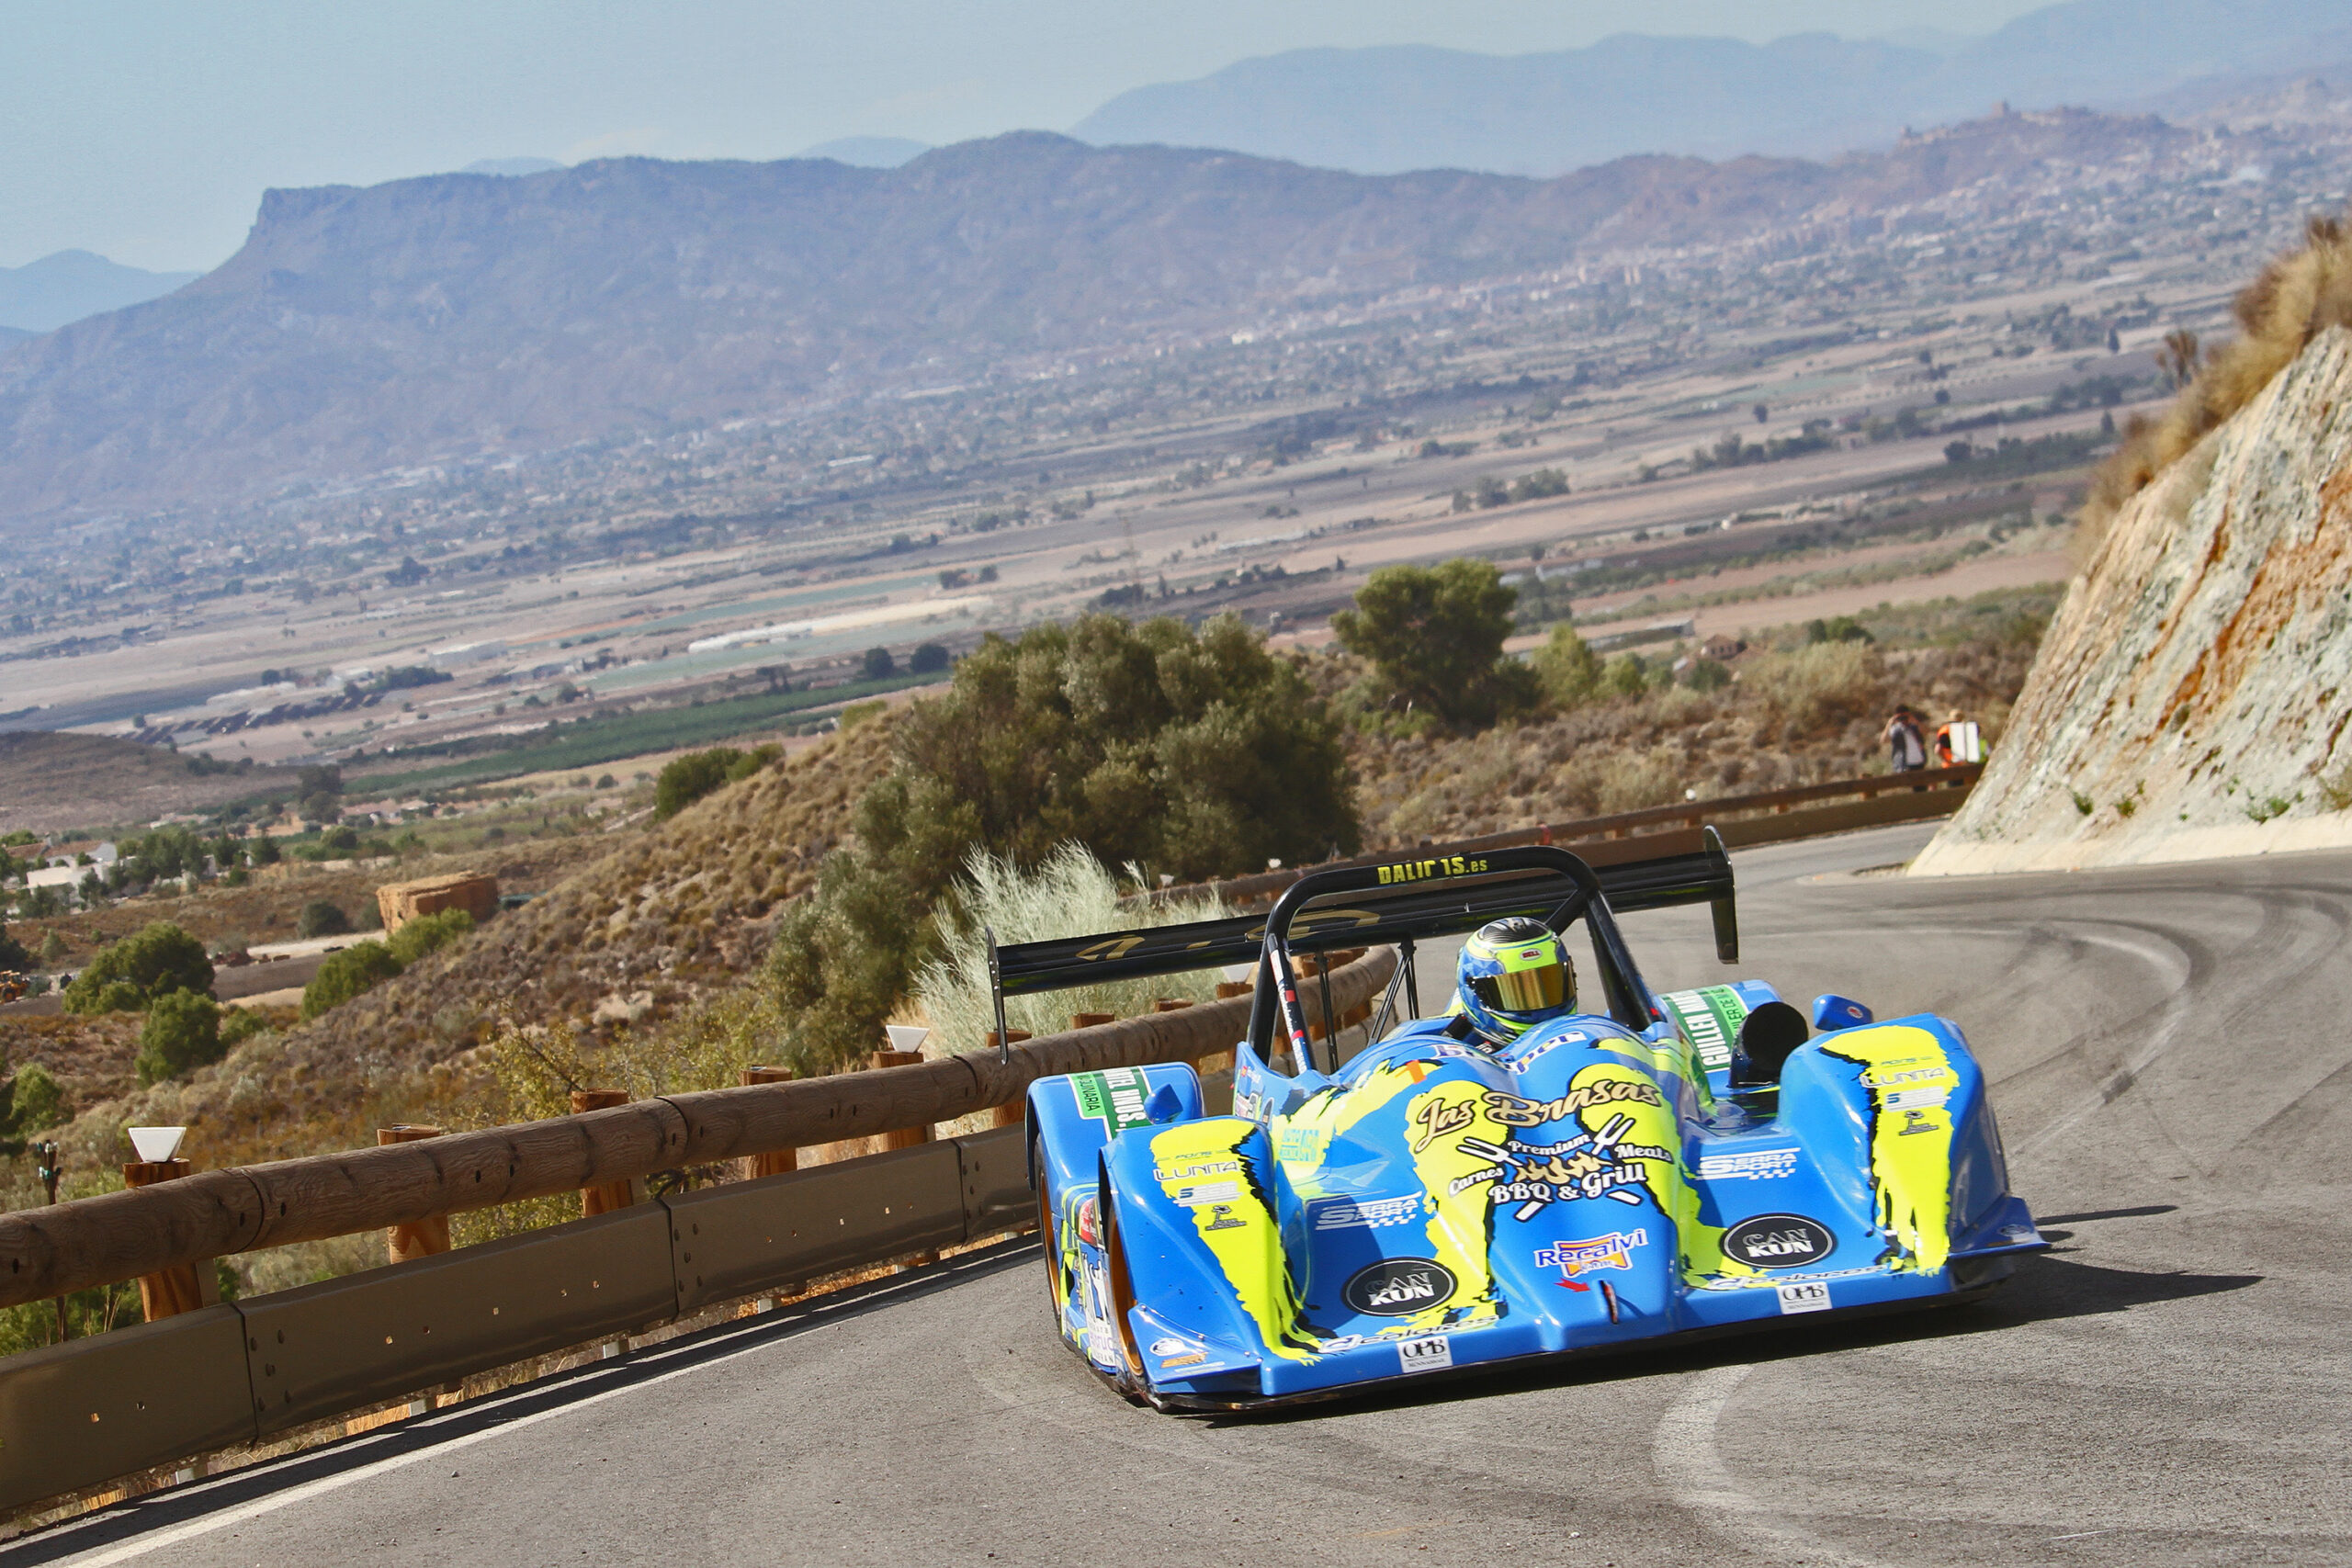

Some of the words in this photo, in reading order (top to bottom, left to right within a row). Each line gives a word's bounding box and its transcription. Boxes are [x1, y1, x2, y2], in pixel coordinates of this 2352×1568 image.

[1684, 1012, 1732, 1066] GUILLEN
[1860, 1067, 1945, 1088] LUNITA
[1481, 1079, 1662, 1128] Brasas
[1155, 1161, 1238, 1181] LUNITA
[1449, 1166, 1505, 1197] Carnes
[1508, 1134, 1591, 1156] Premium
[1614, 1144, 1673, 1163] Meats
[1488, 1182, 1554, 1204] BBQ
[1558, 1185, 1581, 1201] &
[1581, 1163, 1647, 1198] Grill
[1742, 1227, 1809, 1247] CAN
[1537, 1230, 1645, 1267] Recalvi
[1746, 1240, 1815, 1258] KUN
[1364, 1272, 1430, 1293] CAN
[1782, 1284, 1826, 1302] OPB
[1368, 1283, 1435, 1306] KUN
[1403, 1338, 1445, 1359] OPB
